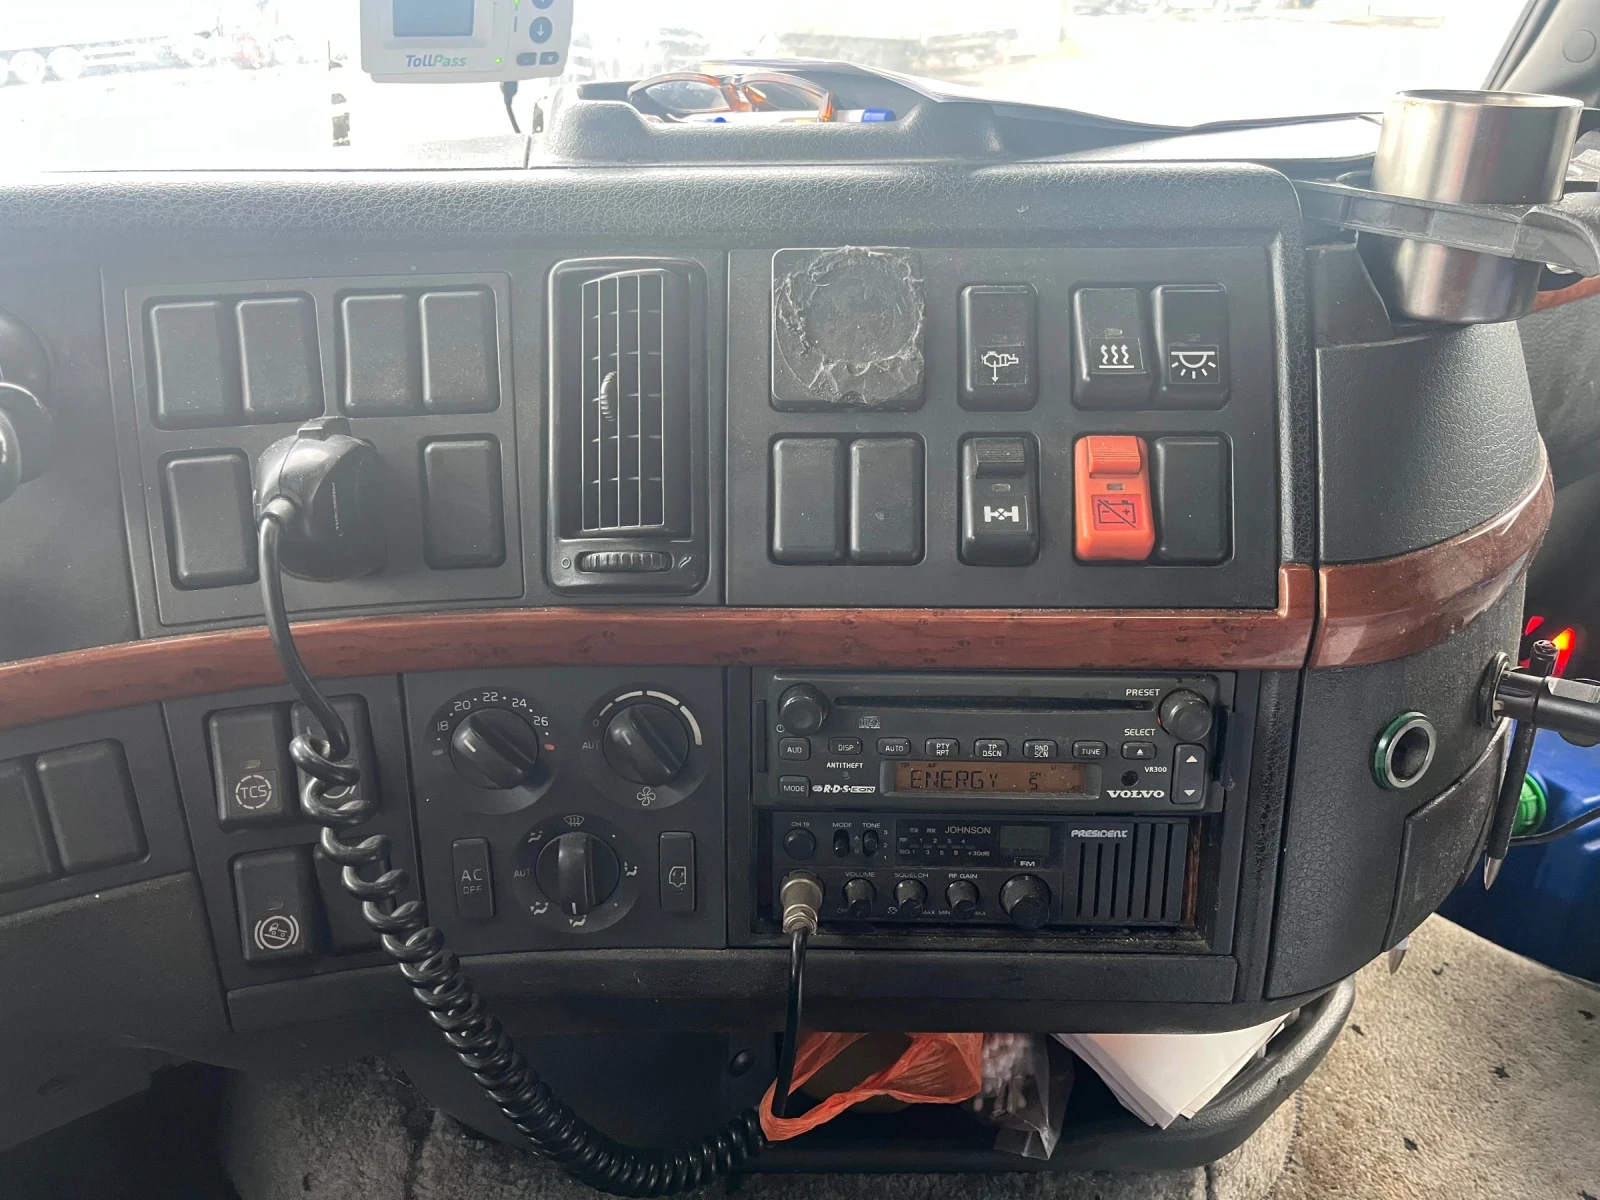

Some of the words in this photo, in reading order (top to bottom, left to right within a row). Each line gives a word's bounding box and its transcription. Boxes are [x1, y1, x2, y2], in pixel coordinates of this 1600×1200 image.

[405, 54, 467, 68] TollPass
[482, 691, 499, 702] 22
[1125, 688, 1160, 697] PRESET
[453, 700, 471, 712] 20
[511, 697, 527, 708] 24
[436, 720, 449, 731] 18
[533, 715, 549, 727] 26
[1124, 728, 1156, 737] SELECT
[582, 740, 600, 751] AUT
[786, 746, 803, 754] AUD
[837, 743, 854, 752] DISP
[885, 744, 904, 753] AUTO
[1081, 748, 1100, 756] TUNE
[910, 769, 998, 789] ENERGY
[240, 784, 268, 799] TCS
[783, 785, 805, 793] MODE
[1106, 789, 1165, 798] VOLVO
[944, 825, 992, 835] JOHNSON
[460, 868, 483, 883] AC
[513, 867, 531, 878] AUT
[462, 884, 483, 896] OFF
